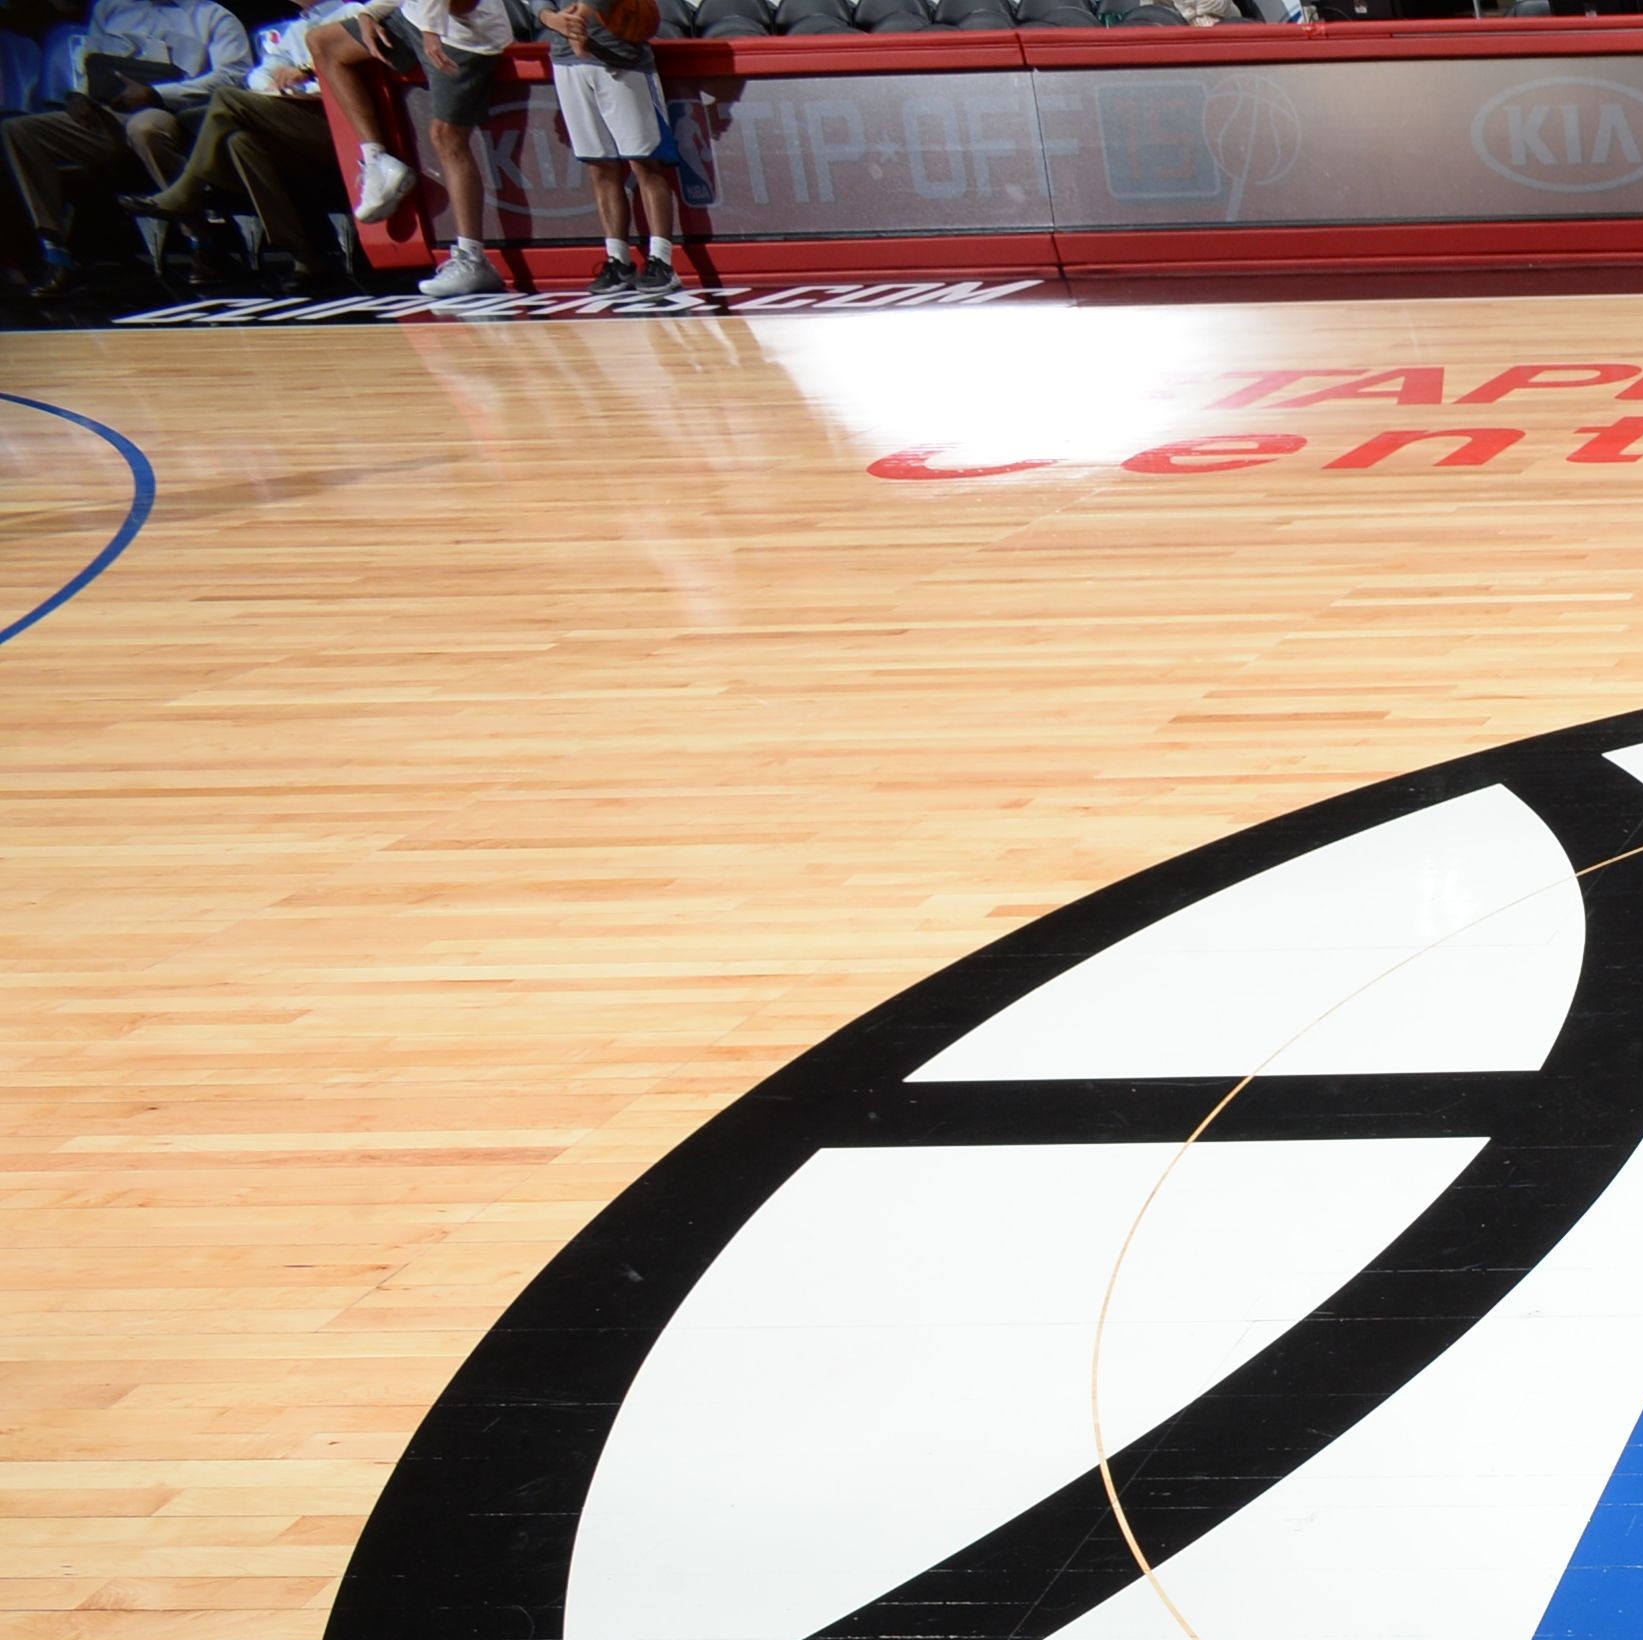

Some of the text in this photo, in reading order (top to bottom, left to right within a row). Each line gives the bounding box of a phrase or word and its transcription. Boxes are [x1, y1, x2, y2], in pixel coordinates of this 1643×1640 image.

[481, 129, 584, 190] KI
[1502, 102, 1643, 167] KIA
[110, 279, 1045, 324] CLIPPERS.COM
